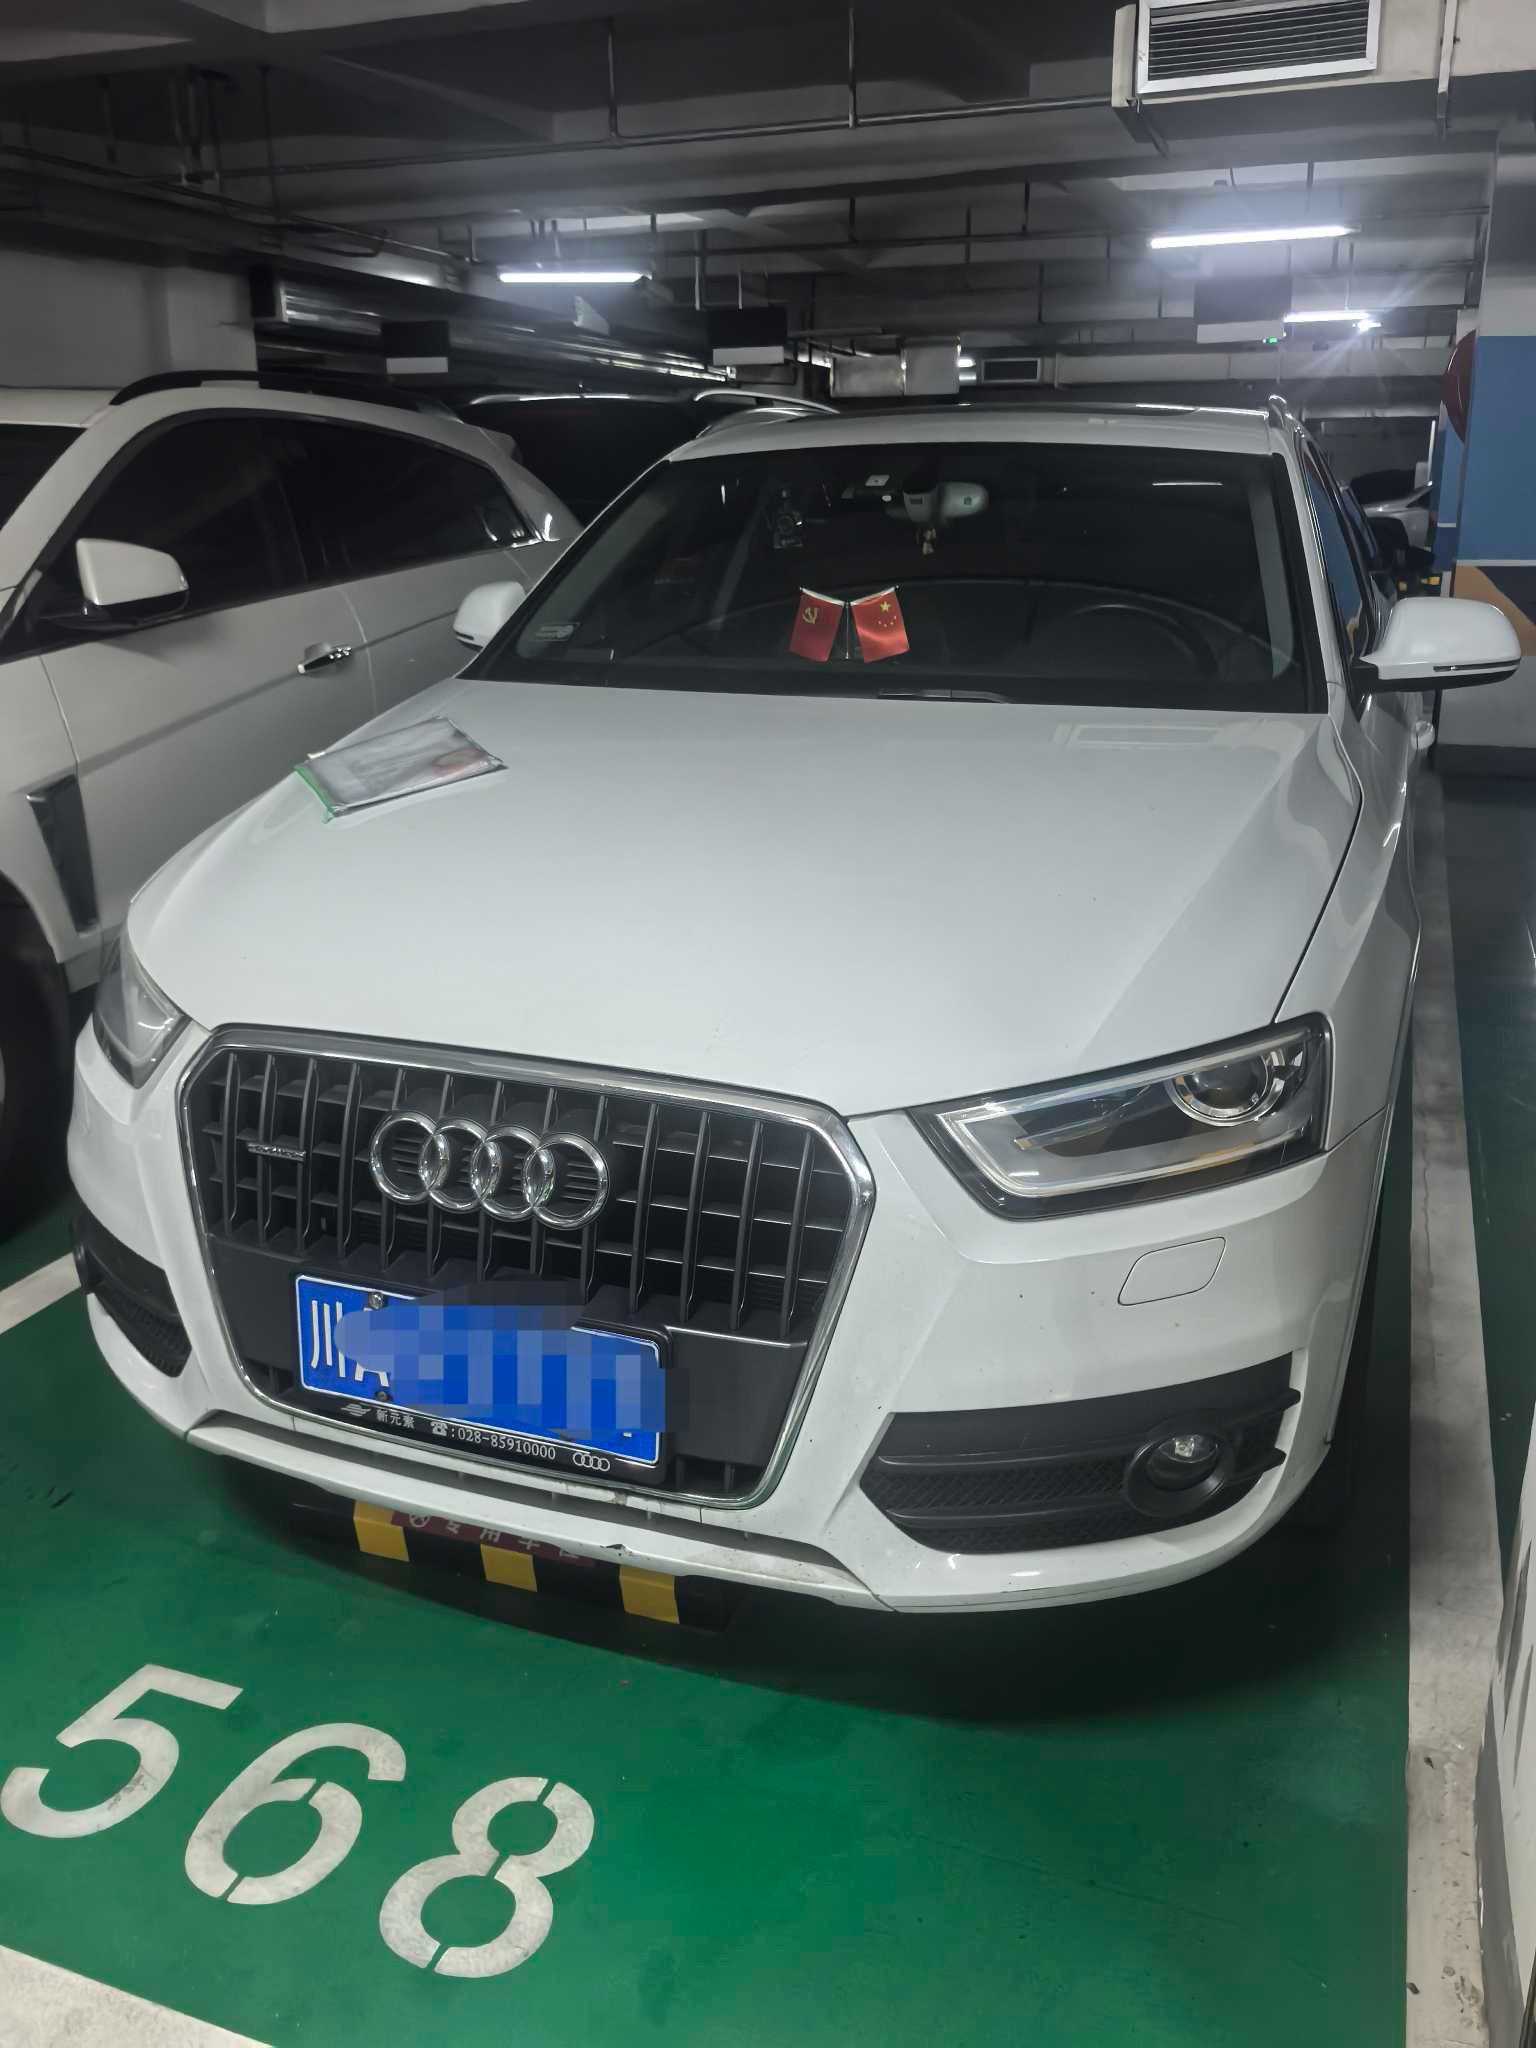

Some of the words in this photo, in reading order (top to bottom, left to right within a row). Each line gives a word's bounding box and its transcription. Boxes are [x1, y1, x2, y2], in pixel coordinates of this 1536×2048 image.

[376, 1408, 415, 1429] 新元素
[0, 1664, 595, 1978] 568
